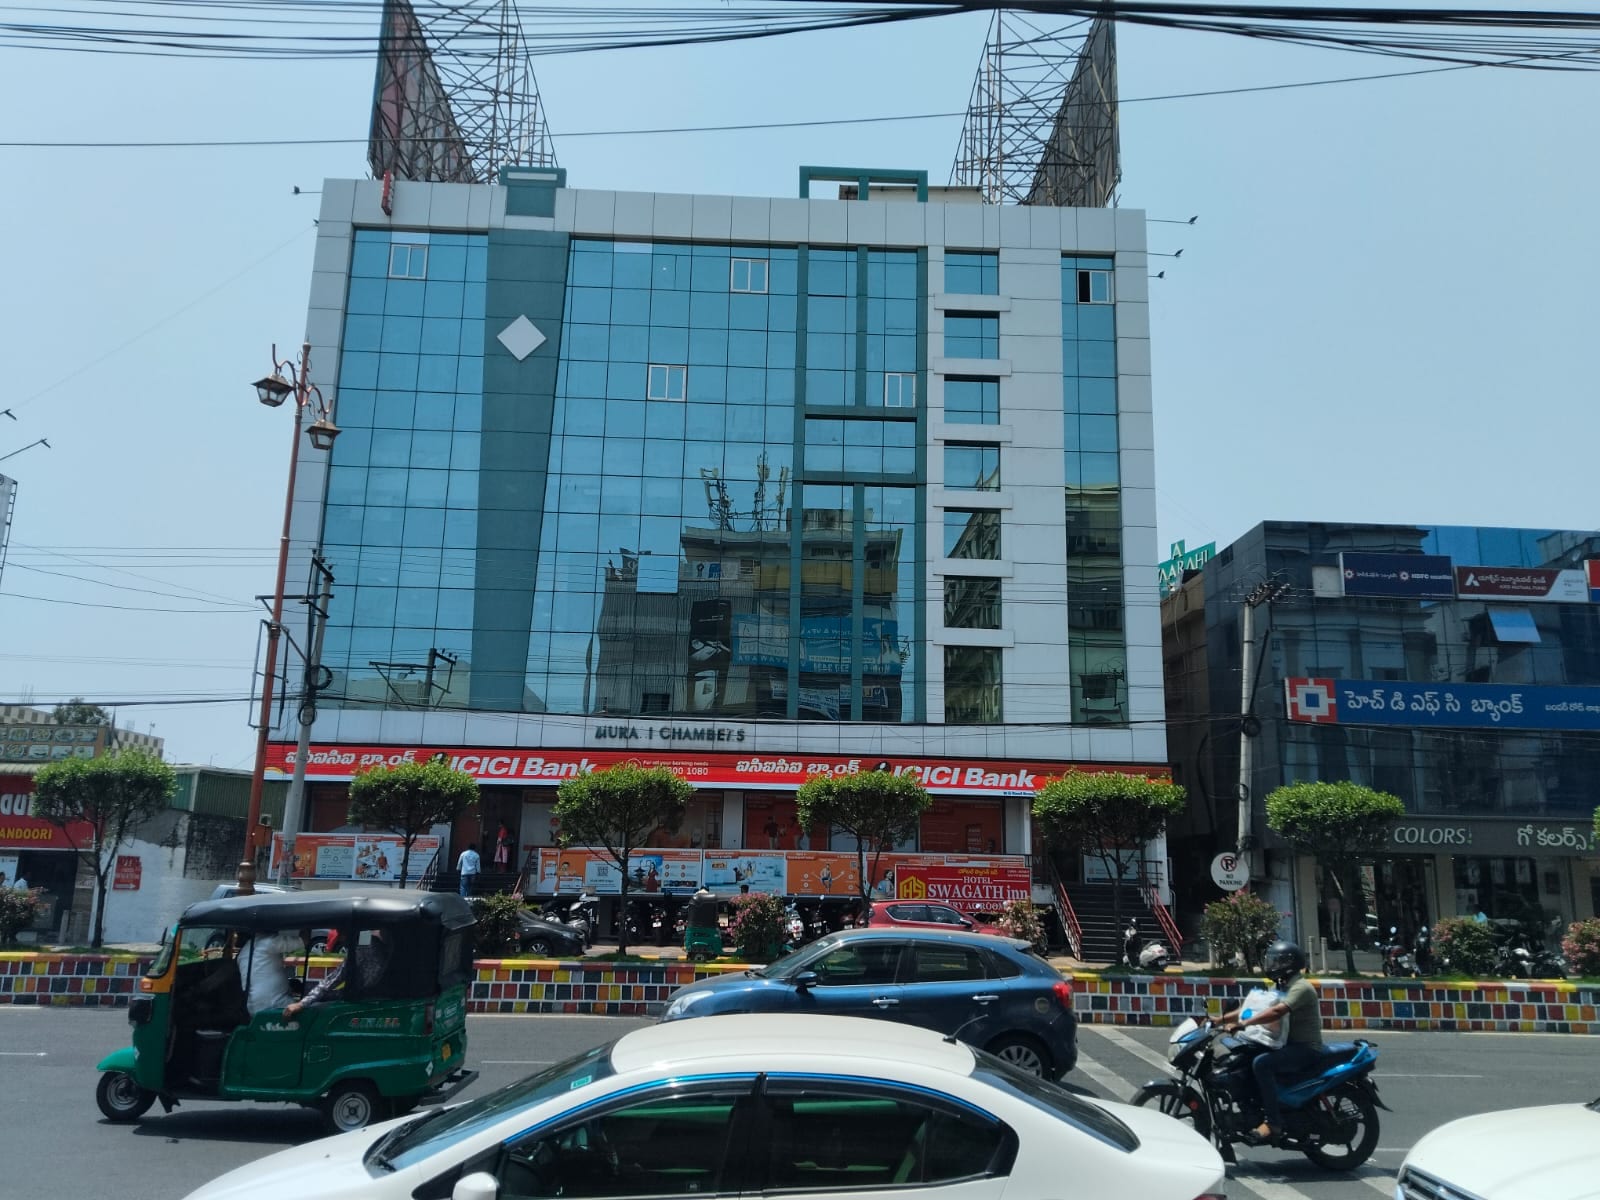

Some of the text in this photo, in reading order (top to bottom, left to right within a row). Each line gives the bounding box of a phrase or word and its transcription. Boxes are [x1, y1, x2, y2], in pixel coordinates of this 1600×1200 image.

[1471, 693, 1524, 722] బ్యాంక్
[450, 755, 598, 777] ICICI Bank
[687, 767, 709, 776] 1080
[735, 758, 861, 779] ఐసిఐసిఐ బ్యాంక్
[964, 767, 1036, 788] Bank
[963, 876, 993, 885] HOTEL
[927, 883, 1028, 900] SWAGATH inn
